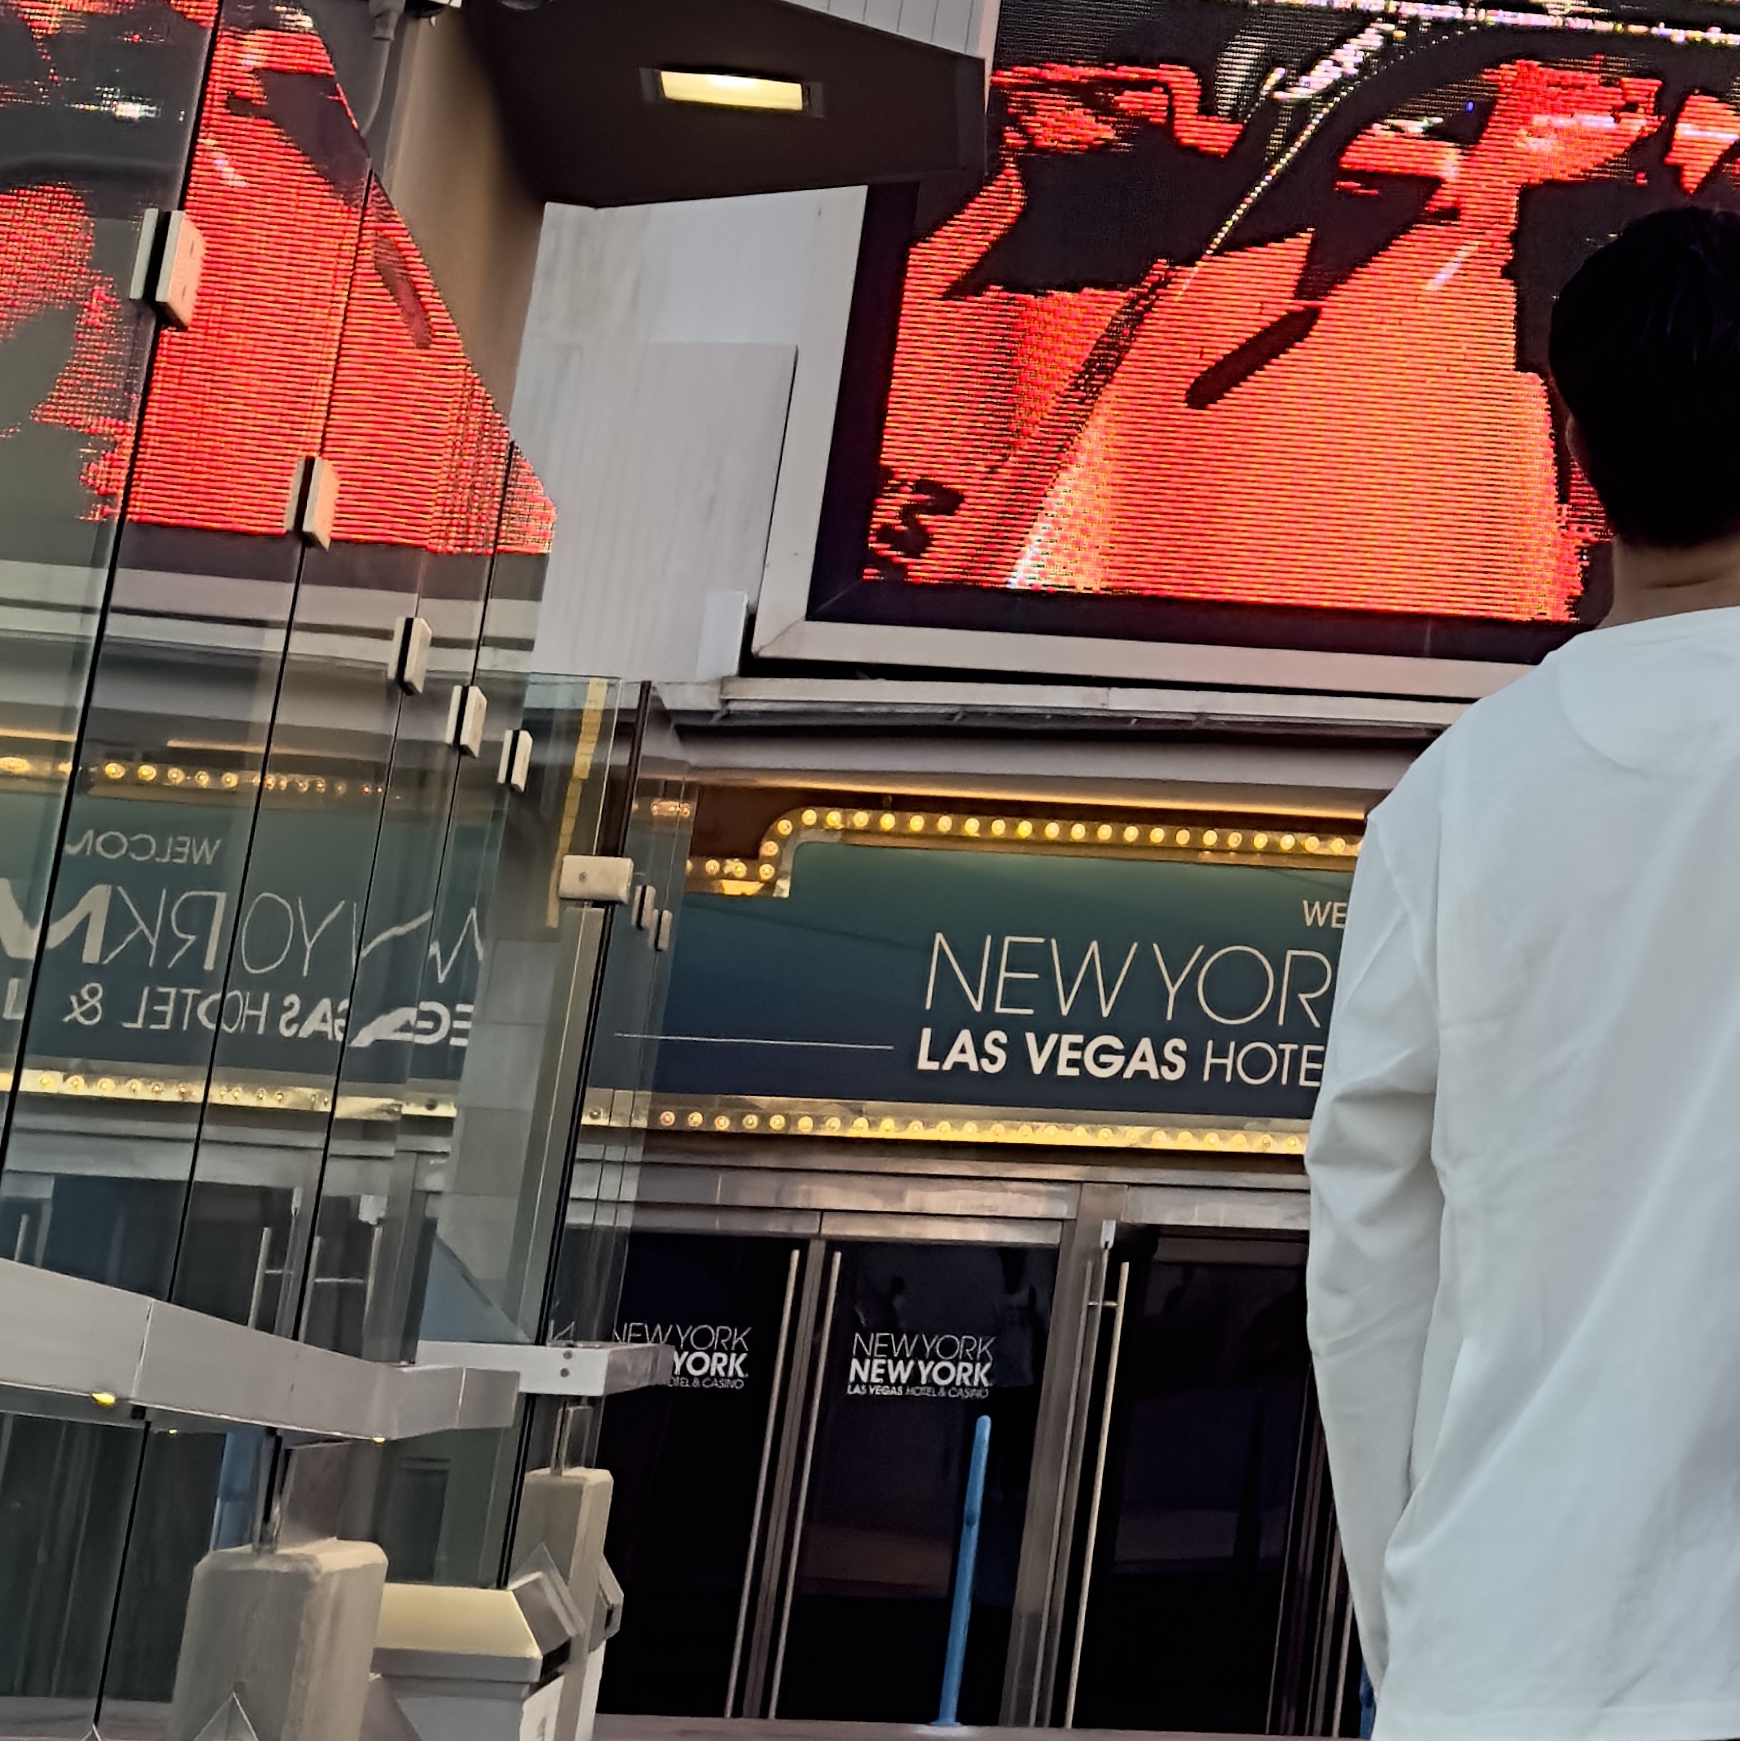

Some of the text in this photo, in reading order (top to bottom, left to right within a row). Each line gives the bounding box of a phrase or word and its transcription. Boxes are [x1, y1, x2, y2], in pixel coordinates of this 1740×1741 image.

[924, 932, 1333, 1028] NEW YOR
[917, 1026, 1325, 1088] LAS VEGAS HOTE
[676, 1324, 752, 1352] YORK
[852, 1331, 997, 1361] NEW YORK
[673, 1350, 748, 1378] YORK
[849, 1358, 994, 1387] NEW YORK
[668, 1376, 691, 1388] OTEL
[701, 1376, 745, 1390] CASINO
[847, 1384, 867, 1395] LAS
[869, 1384, 903, 1396] VEGAS
